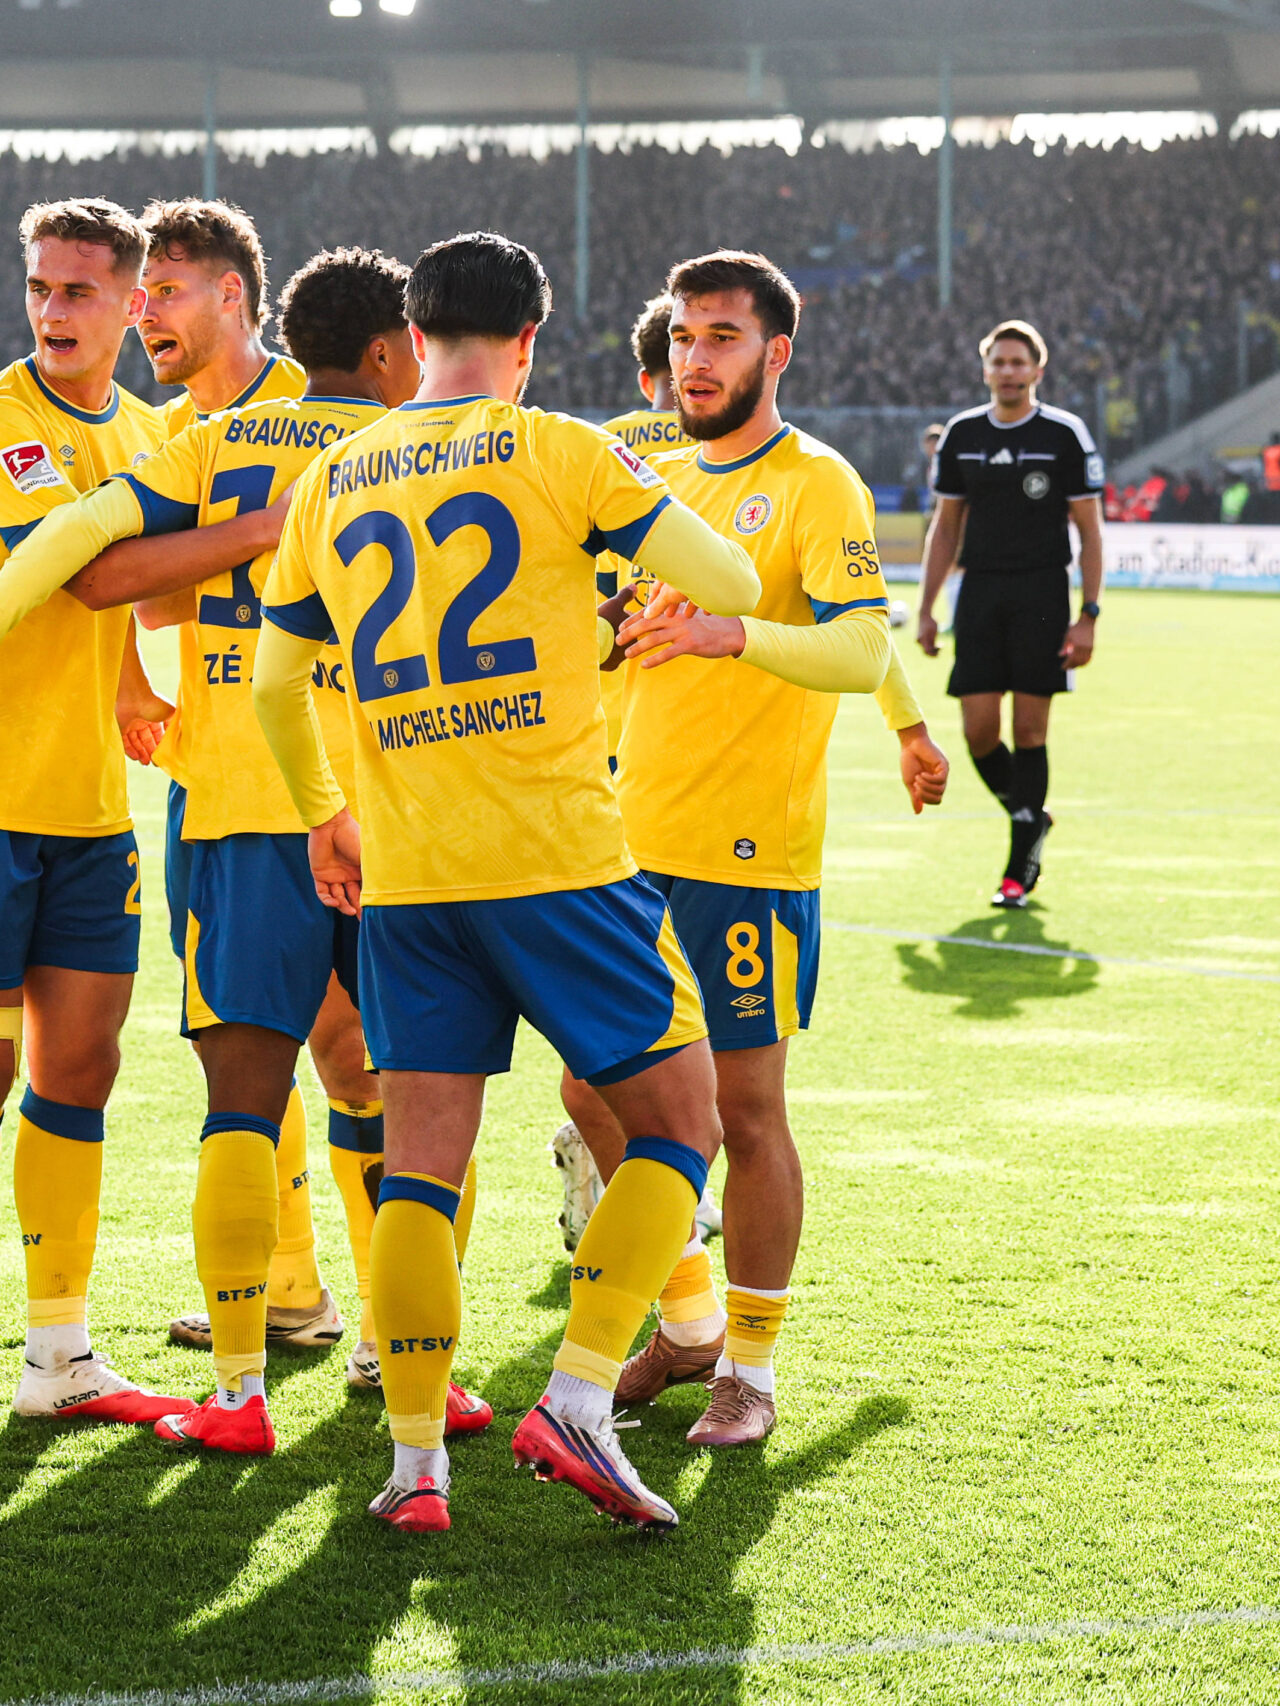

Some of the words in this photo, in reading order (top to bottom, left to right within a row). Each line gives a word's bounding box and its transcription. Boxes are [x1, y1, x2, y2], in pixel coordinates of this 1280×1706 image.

[328, 430, 515, 499] BRAUNSCHWEIG
[333, 491, 537, 703] 22
[204, 644, 242, 685] ZÉ
[378, 706, 451, 752] MICHELE
[450, 690, 546, 738] SANCHEZ
[726, 921, 765, 989] 8
[737, 1007, 766, 1019] umbro
[570, 1265, 603, 1282] SV
[217, 1281, 267, 1302] BTSV
[736, 1320, 767, 1331] umbro
[389, 1335, 454, 1355] BTSV
[53, 1389, 100, 1409] ULTRA
